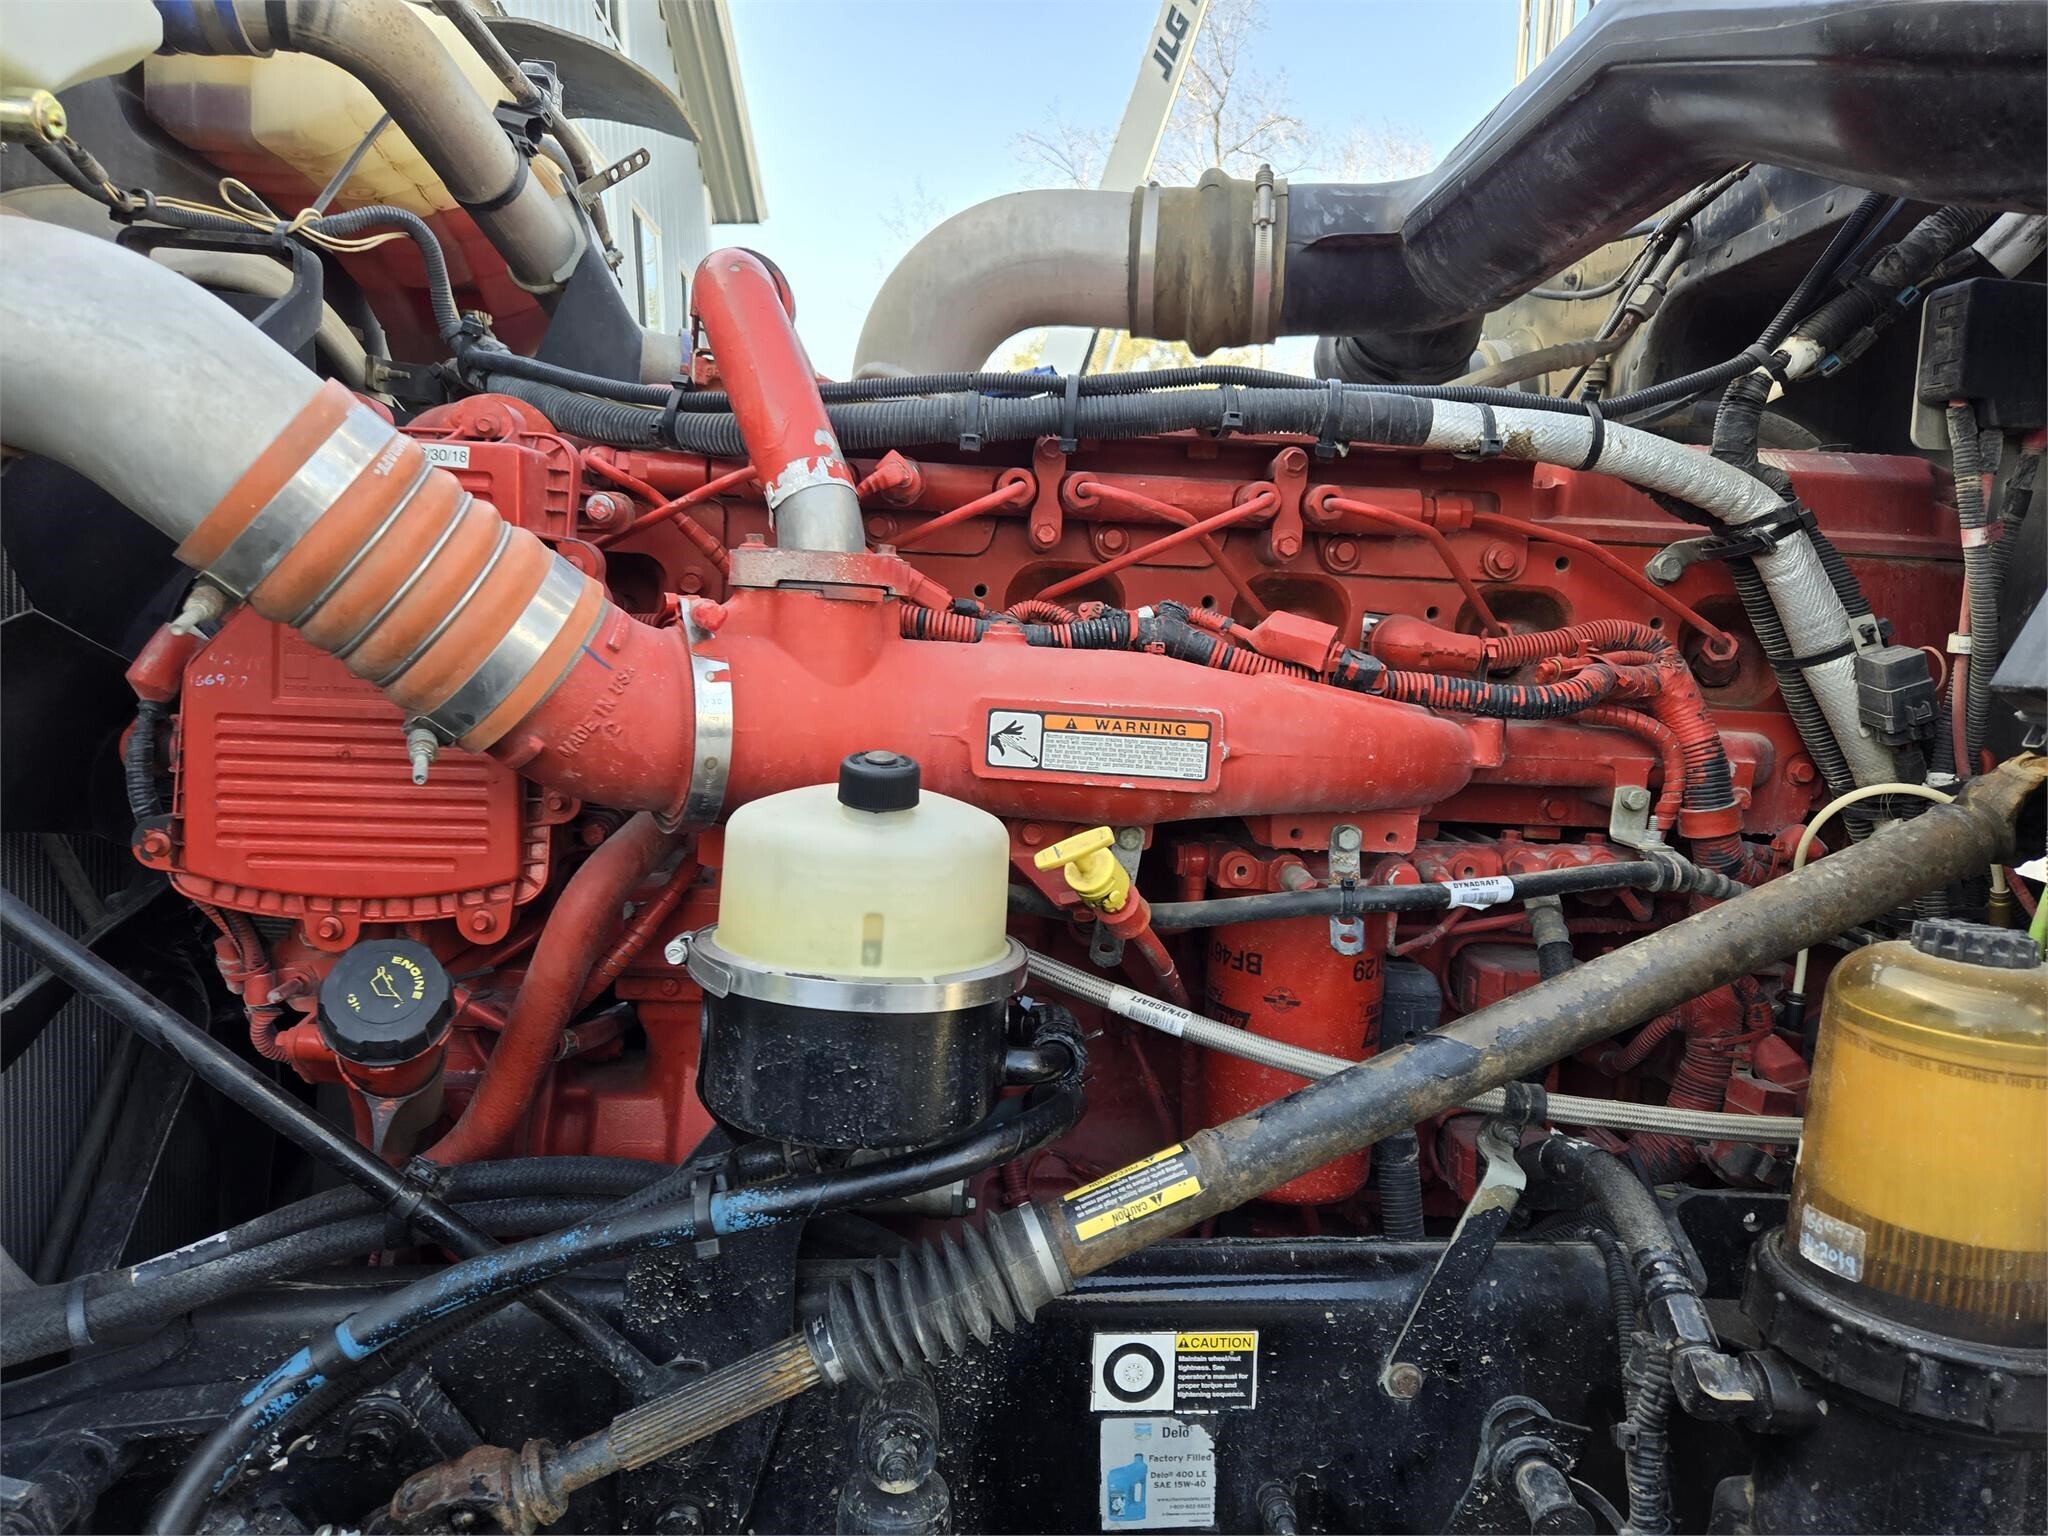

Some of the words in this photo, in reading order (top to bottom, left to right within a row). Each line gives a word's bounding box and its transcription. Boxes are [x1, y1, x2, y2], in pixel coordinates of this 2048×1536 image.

[1153, 4, 1190, 82] JLG
[557, 720, 600, 758] MADE
[592, 699, 616, 718] IN
[1095, 719, 1187, 736] WARNING
[391, 956, 424, 1000] ENGINE
[1130, 995, 1189, 1019] DYNACRAFT
[1938, 1064, 1999, 1085] REACHES
[2004, 1076, 2032, 1089] THIS
[1110, 1200, 1148, 1223] CAUTION
[1190, 1337, 1251, 1348] CAUTION
[1178, 1364, 1211, 1372] tightness.
[1177, 1391, 1211, 1399] tightening
[1162, 1425, 1189, 1438] Delo
[1149, 1454, 1183, 1463] Factory
[1186, 1453, 1212, 1461] Filled
[1174, 1480, 1206, 1488] 15W-40
